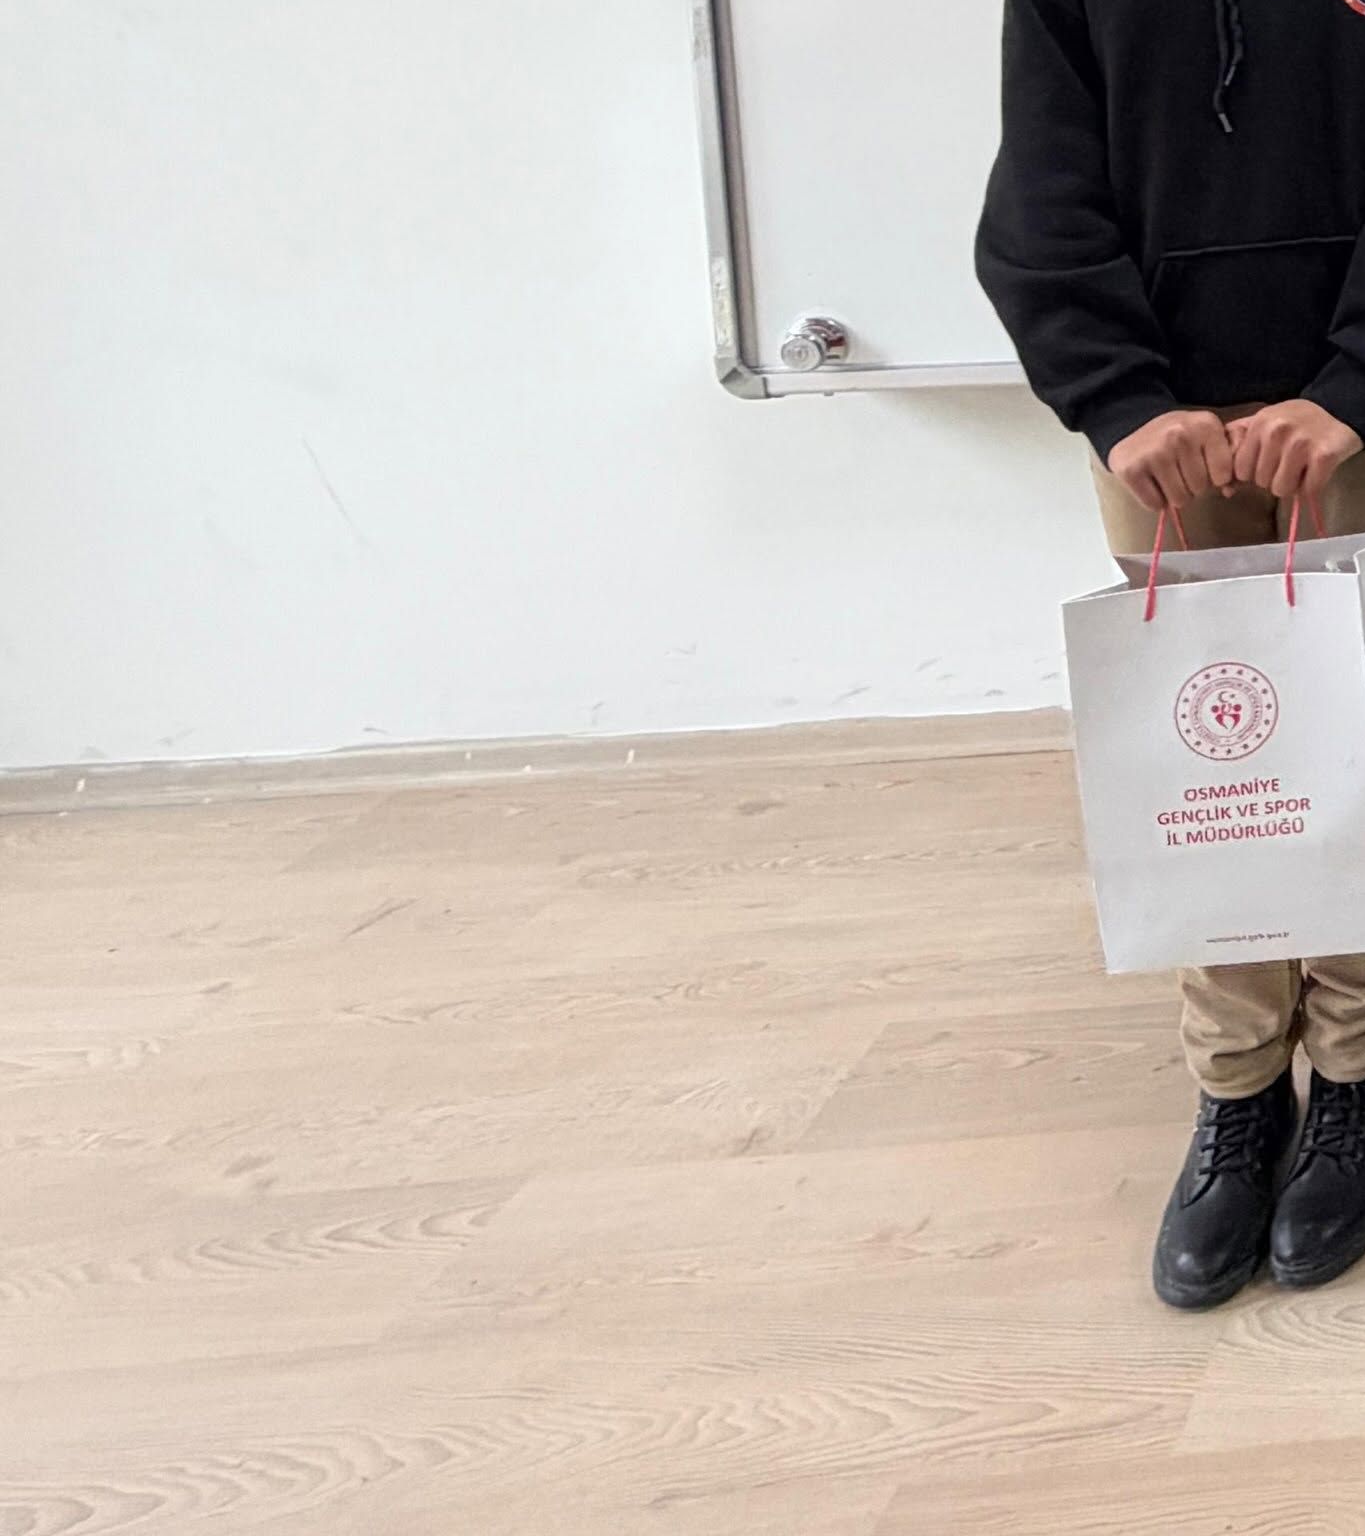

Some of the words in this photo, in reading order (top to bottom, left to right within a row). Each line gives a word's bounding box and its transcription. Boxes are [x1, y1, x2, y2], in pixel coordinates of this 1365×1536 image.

[1184, 777, 1280, 802] OSMANİYE
[1157, 805, 1232, 825] GENÇLİK
[1236, 802, 1259, 817] VE
[1264, 798, 1311, 814] SPOR
[1166, 830, 1181, 846] İL
[1186, 817, 1305, 844] MÜDÜRLÜĞÜ
